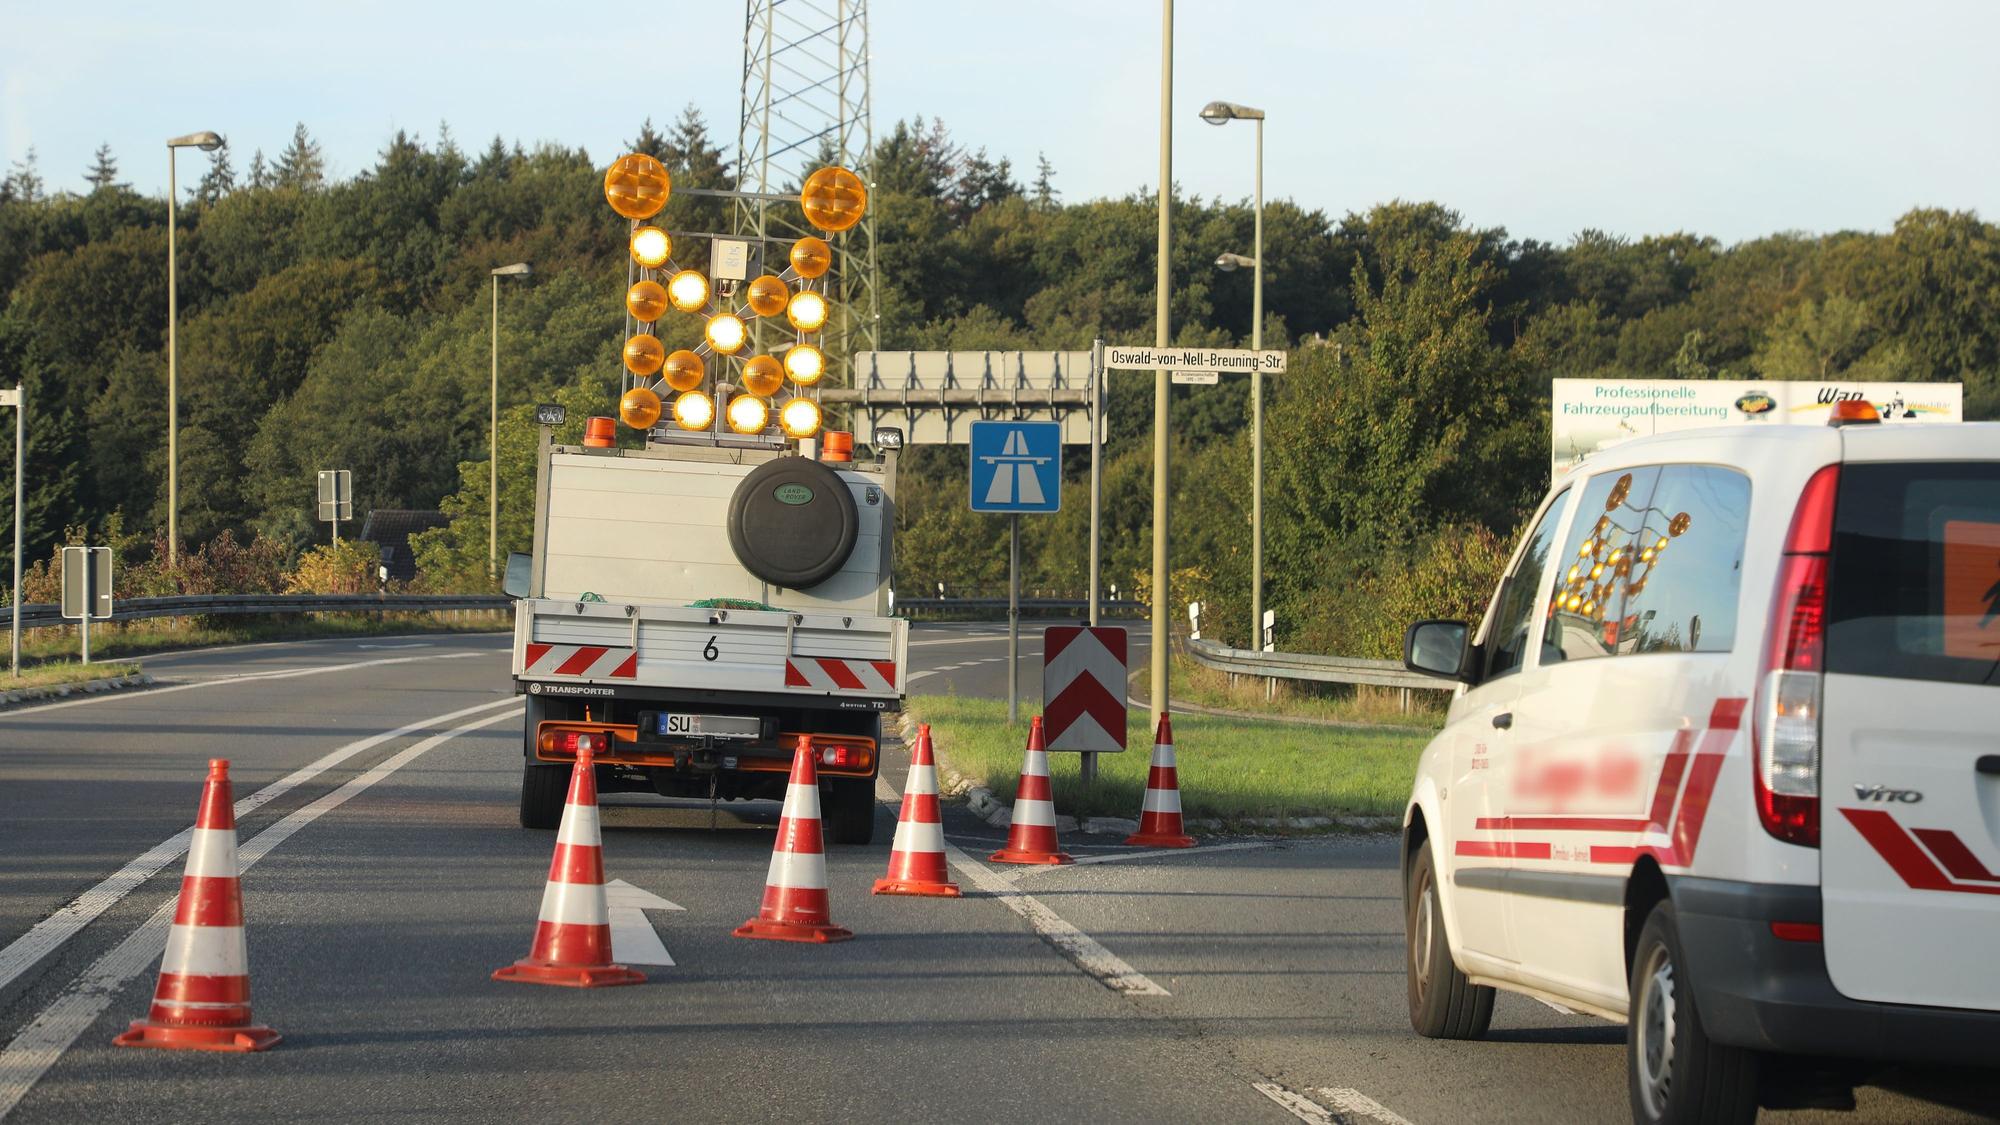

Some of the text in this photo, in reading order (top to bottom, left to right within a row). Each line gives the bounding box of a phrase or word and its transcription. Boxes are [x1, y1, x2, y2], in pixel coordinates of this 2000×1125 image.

[1112, 350, 1284, 371] Oswald-von-Nell-Breuning-Str.
[1595, 386, 1697, 399] Professionelle
[1563, 403, 1728, 419] Fahrzeugaufbereitung
[703, 635, 719, 661] 6
[544, 685, 615, 696] TRANSPORTER
[872, 701, 886, 709] TD
[668, 716, 691, 732] SU
